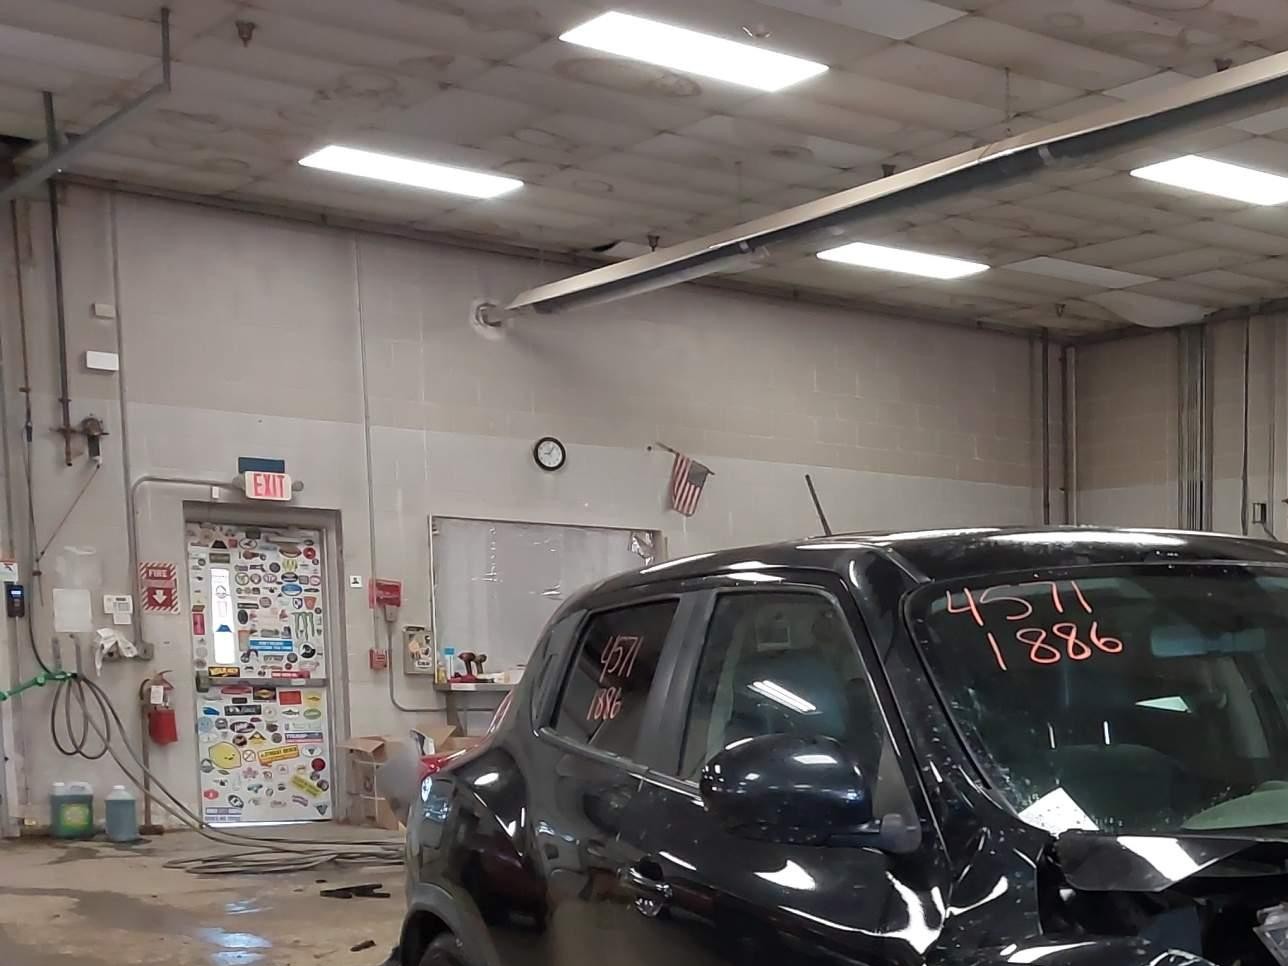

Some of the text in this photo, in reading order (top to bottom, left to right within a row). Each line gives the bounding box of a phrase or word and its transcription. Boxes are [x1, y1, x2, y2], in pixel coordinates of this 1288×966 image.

[253, 473, 285, 498] EXIT
[946, 580, 1093, 626] 4571
[600, 635, 643, 682] 4571
[987, 621, 1123, 671] 1886
[586, 686, 622, 721] 1886
